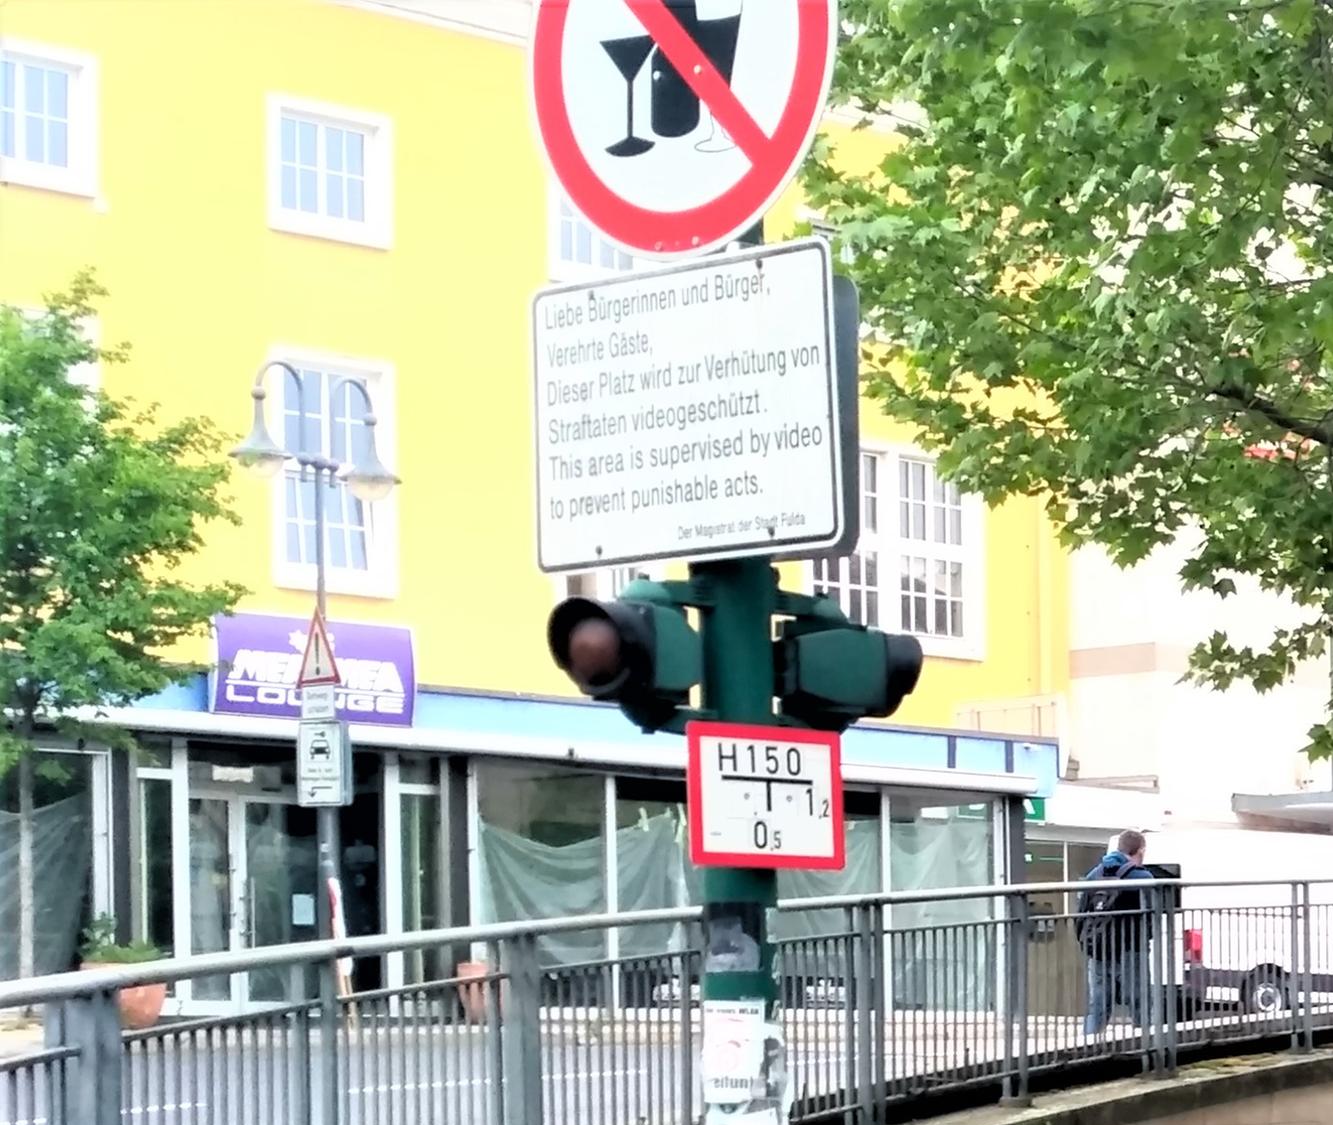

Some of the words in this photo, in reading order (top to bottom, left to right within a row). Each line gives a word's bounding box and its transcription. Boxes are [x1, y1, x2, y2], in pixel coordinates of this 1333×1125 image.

[545, 302, 583, 330] Liebe
[588, 289, 677, 324] Bürgerinnen
[682, 277, 709, 306] und
[714, 273, 770, 302] Bürger,
[547, 337, 604, 368] Verehrte
[608, 330, 653, 358] Gäste,
[547, 380, 594, 407] Dieser
[599, 370, 635, 398] Platz
[640, 362, 672, 390] wird
[678, 362, 701, 385] zur
[704, 348, 786, 381] Verhütung
[791, 344, 819, 368] von
[549, 413, 627, 444] Straftaten
[549, 454, 583, 481] This
[588, 452, 624, 477] area
[630, 445, 644, 470] is
[650, 429, 744, 470] supervised
[750, 428, 770, 458] by
[775, 422, 823, 450] video
[550, 496, 564, 520] to
[570, 487, 626, 522] prevent
[632, 474, 718, 514] punishable
[725, 470, 764, 498] acts.
[678, 525, 693, 540] Der
